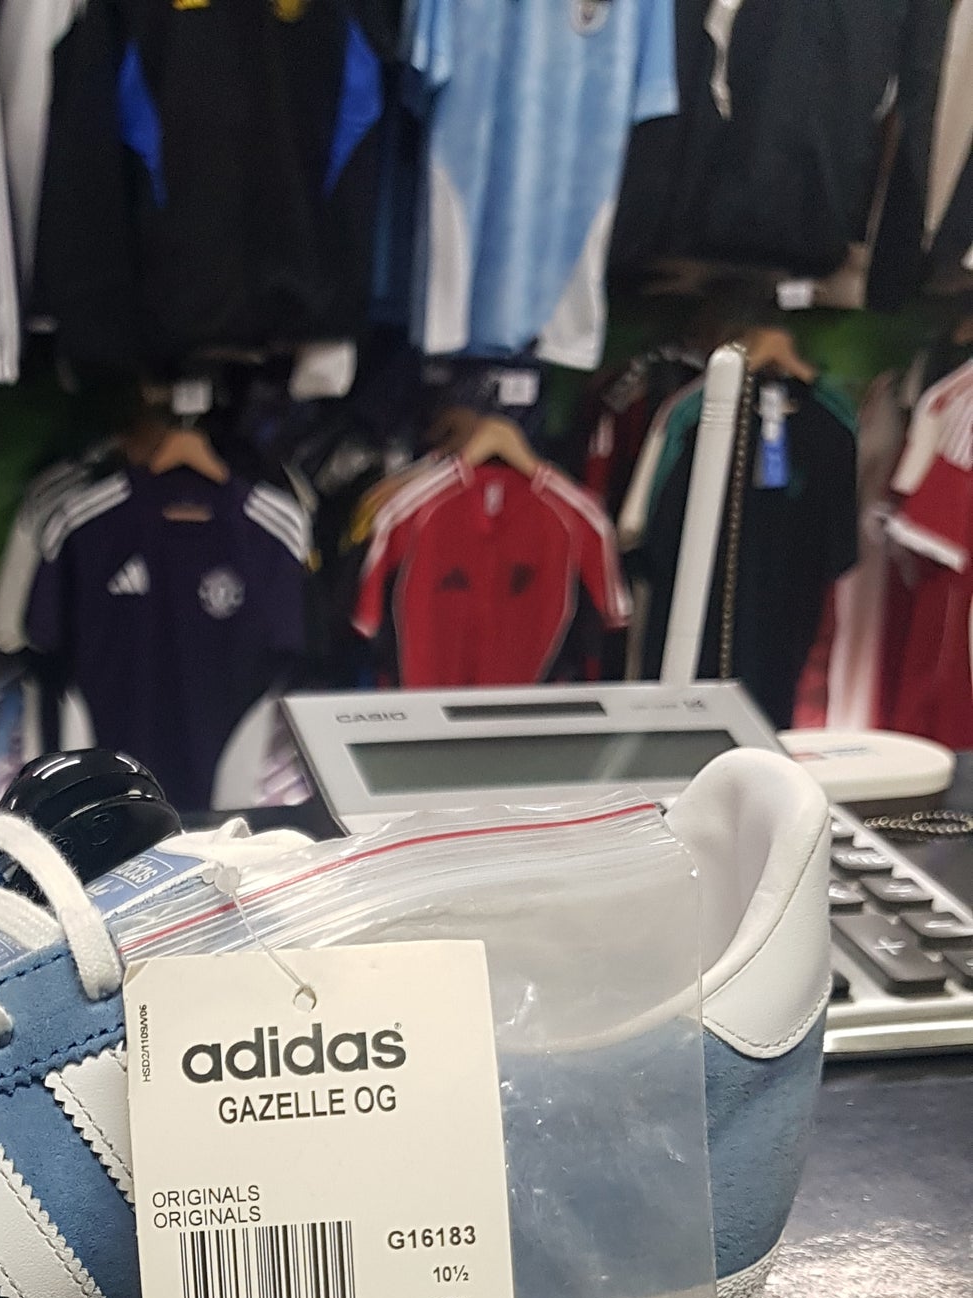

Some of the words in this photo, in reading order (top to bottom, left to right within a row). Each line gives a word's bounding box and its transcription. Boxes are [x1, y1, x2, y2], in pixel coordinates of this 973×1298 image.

[335, 711, 408, 724] CASIO
[181, 1022, 407, 1084] adidas
[218, 1088, 346, 1124] GAZELLE
[354, 1084, 397, 1114] OG
[152, 1185, 261, 1209] ORIGINALS
[153, 1205, 262, 1229] ORIGINALS
[387, 1225, 477, 1250] G16183
